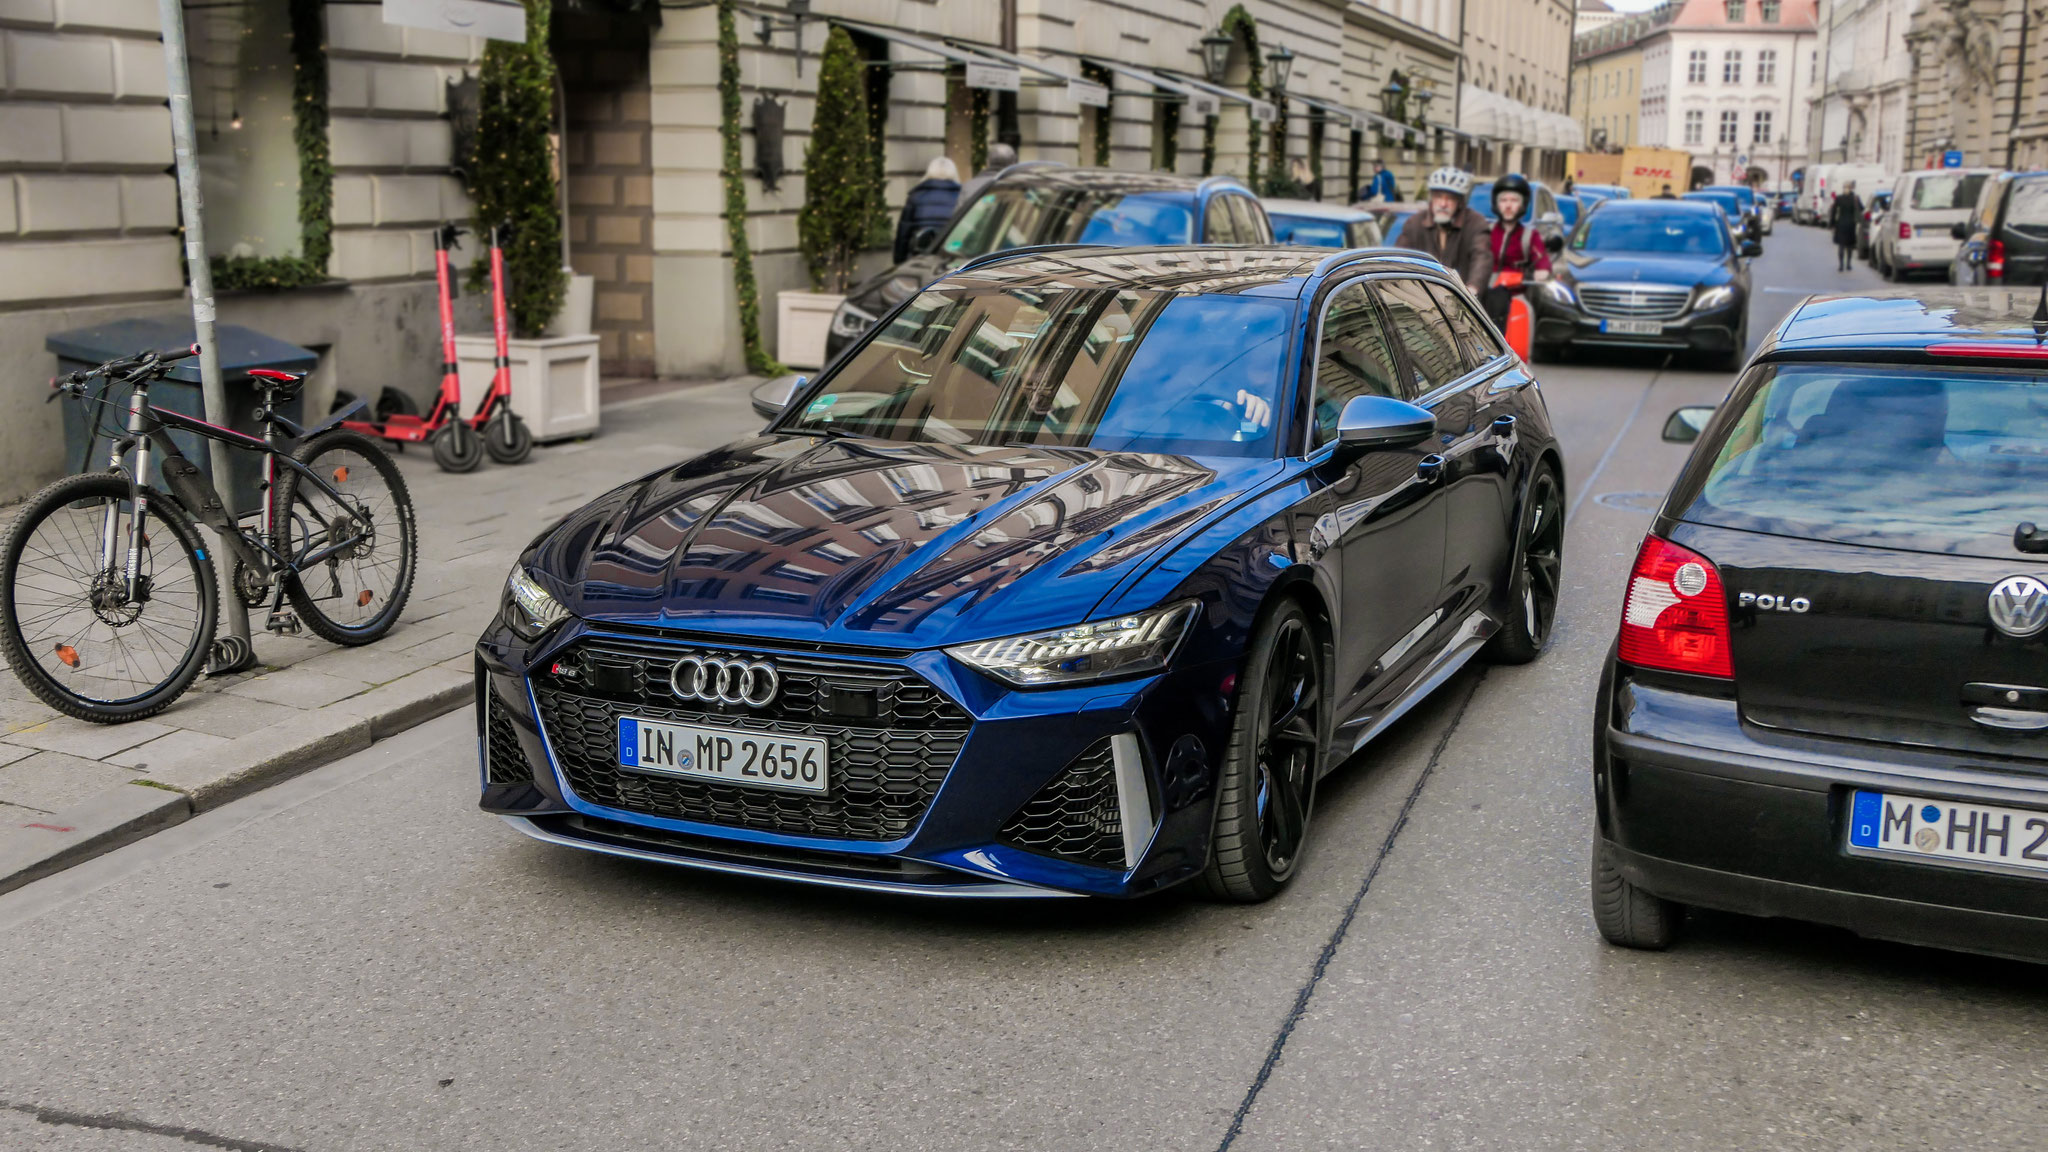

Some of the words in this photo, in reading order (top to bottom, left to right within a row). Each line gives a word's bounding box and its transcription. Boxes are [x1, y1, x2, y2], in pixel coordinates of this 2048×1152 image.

[1633, 166, 1673, 179] DHL
[1738, 592, 1811, 614] POLO
[642, 727, 673, 766] IN
[697, 734, 733, 772] MP
[741, 740, 818, 783] 2656
[1861, 824, 1872, 837] D
[1882, 800, 1913, 845] M
[1946, 808, 2010, 857] HH
[2022, 818, 2048, 862] 2
